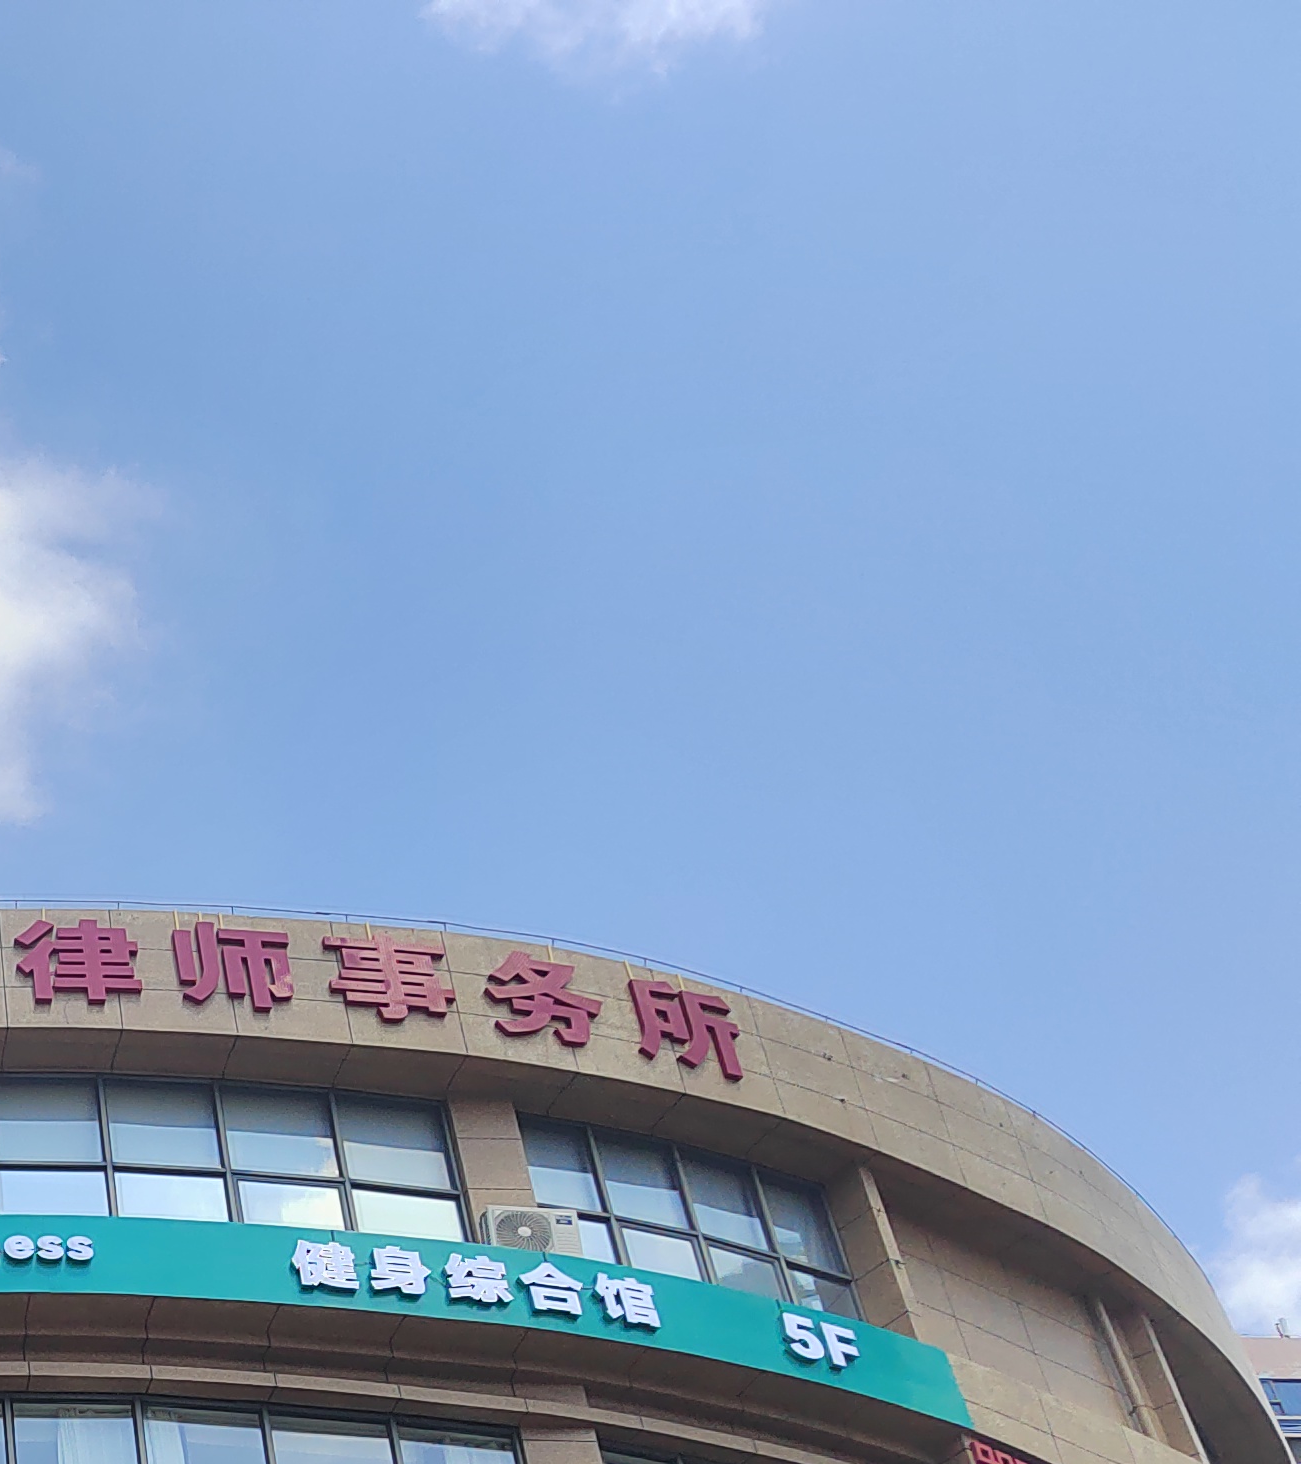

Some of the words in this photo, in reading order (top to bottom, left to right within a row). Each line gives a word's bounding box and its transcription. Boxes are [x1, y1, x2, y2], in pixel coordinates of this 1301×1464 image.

[291, 1237, 661, 1329] 健身综合馆
[782, 1311, 862, 1370] 5F
